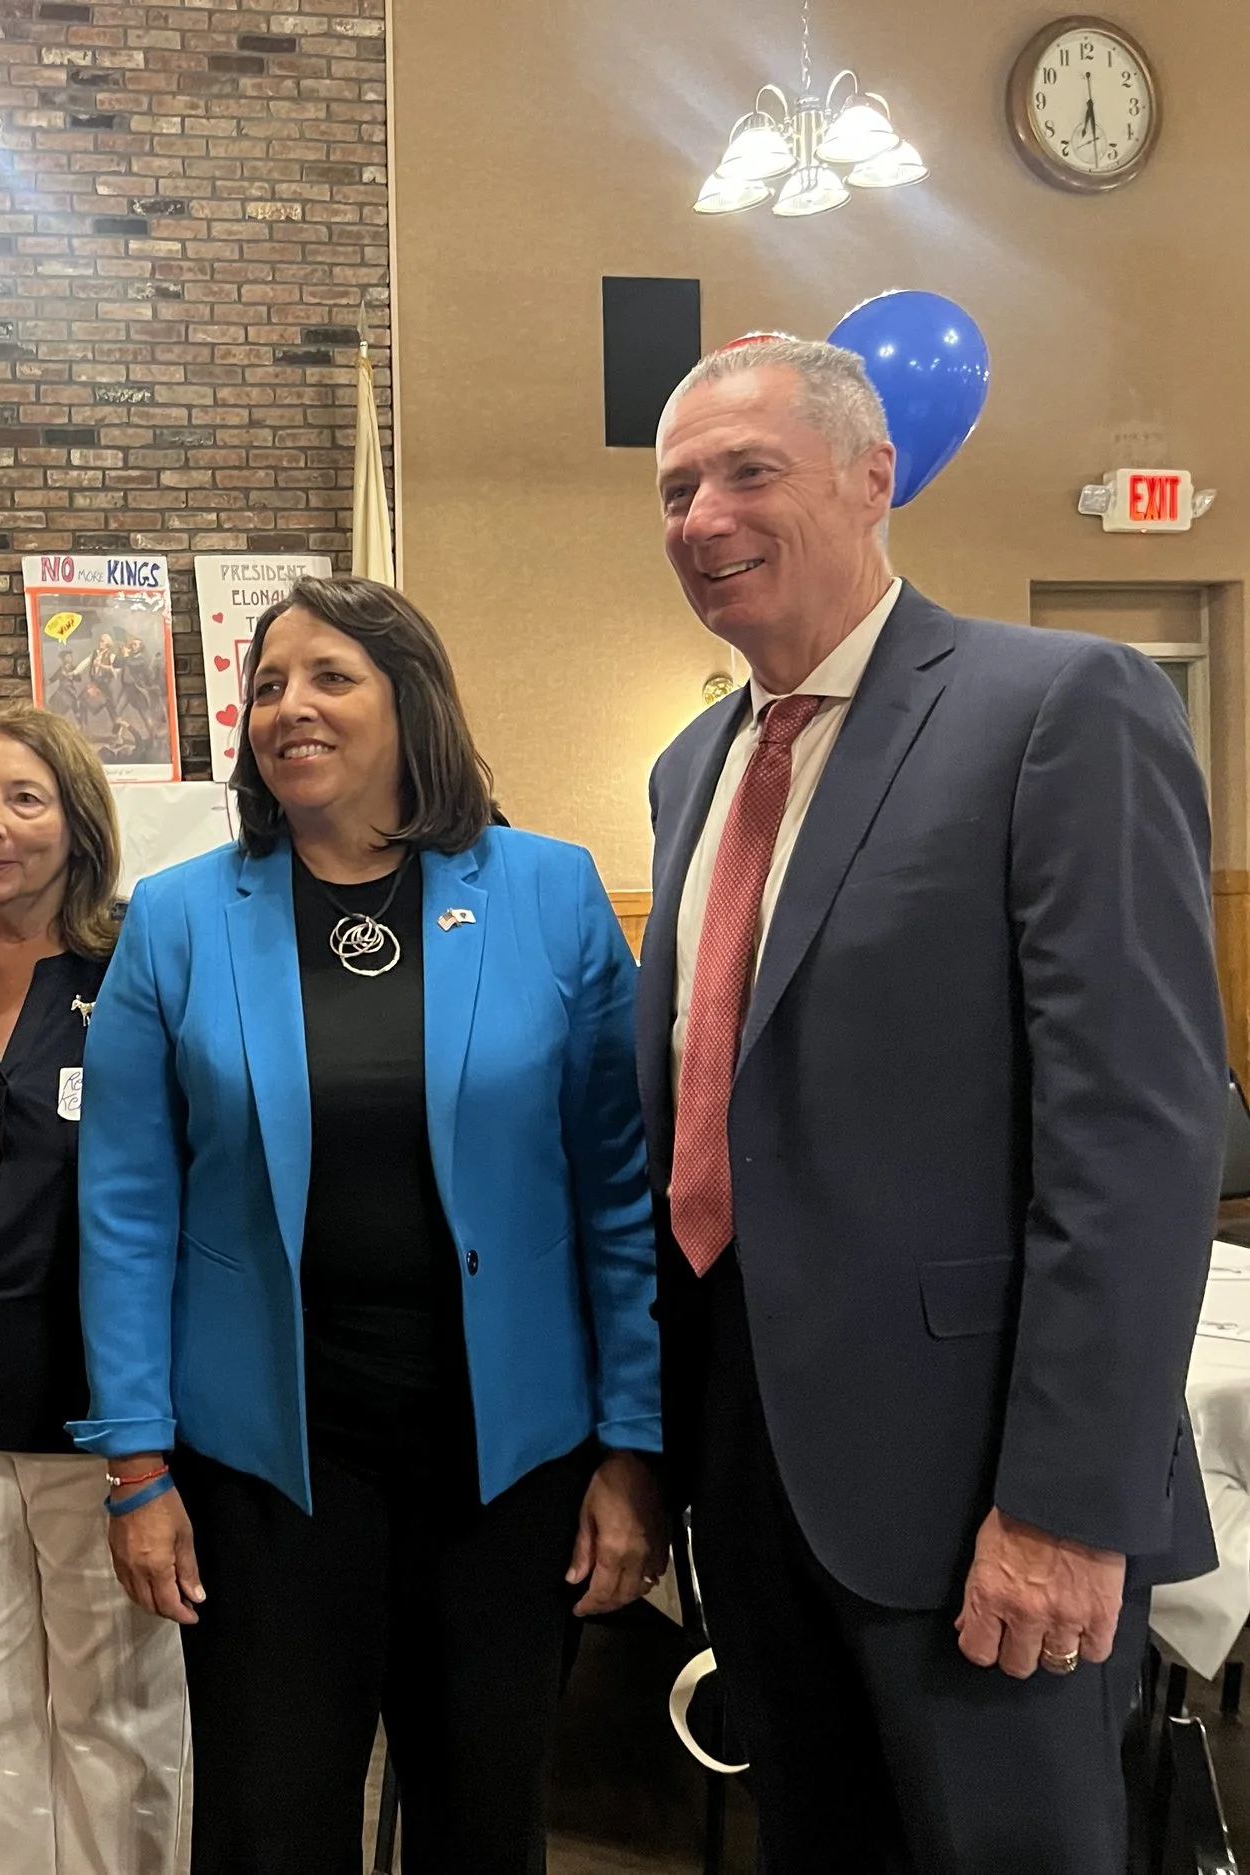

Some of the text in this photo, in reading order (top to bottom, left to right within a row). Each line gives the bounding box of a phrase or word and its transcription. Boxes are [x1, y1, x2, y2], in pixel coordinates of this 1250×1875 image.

[1059, 49, 1069, 67] 11
[1080, 42, 1094, 60] 12
[1107, 50, 1112, 68] 1
[1043, 67, 1057, 85] 10
[1121, 70, 1132, 88] 2
[1035, 91, 1046, 110] 9
[1128, 97, 1140, 116] 3
[1044, 120, 1055, 138] 8
[1060, 140, 1070, 157] 7
[1107, 143, 1118, 160] 5
[1130, 475, 1180, 521] EXIT
[41, 556, 161, 588] NO MORE KINGS
[220, 564, 307, 581] PRESIDENT
